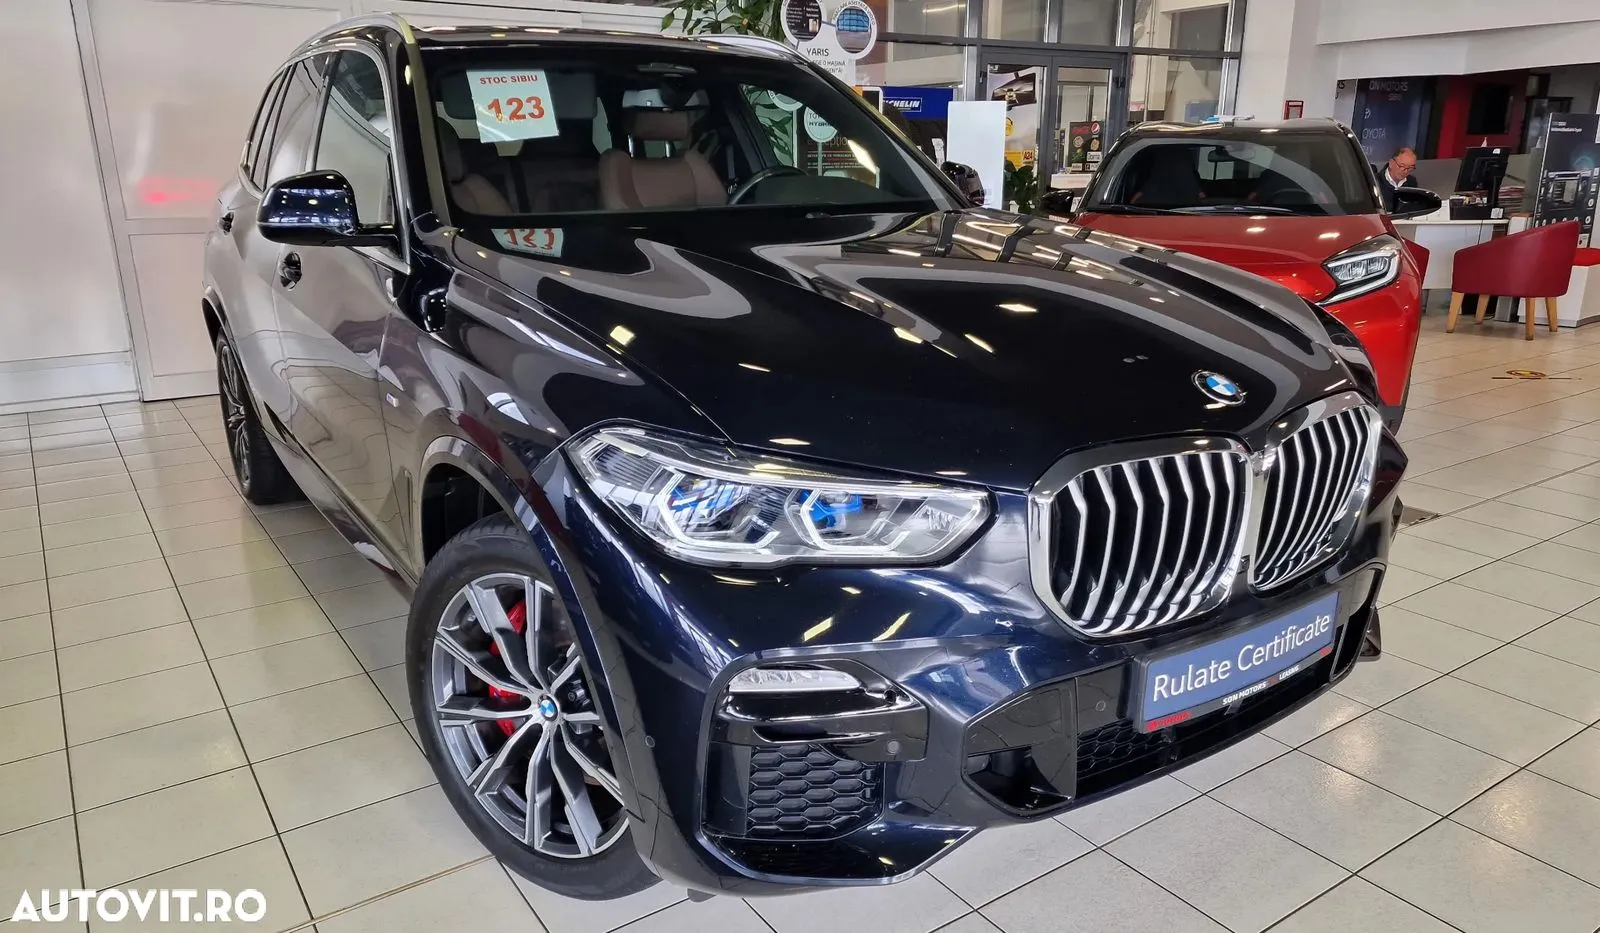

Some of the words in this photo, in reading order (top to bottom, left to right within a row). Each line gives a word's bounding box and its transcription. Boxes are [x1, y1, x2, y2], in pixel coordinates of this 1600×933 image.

[806, 48, 830, 57] YARIS
[480, 76, 507, 85] STOC
[510, 75, 538, 83] SIBIU
[488, 96, 545, 122] 123
[883, 100, 920, 108] HELIN
[1362, 128, 1386, 140] OYOTA
[1153, 660, 1231, 702] Rulate
[1238, 614, 1331, 671] Certificate
[1238, 681, 1267, 698] MOTORS
